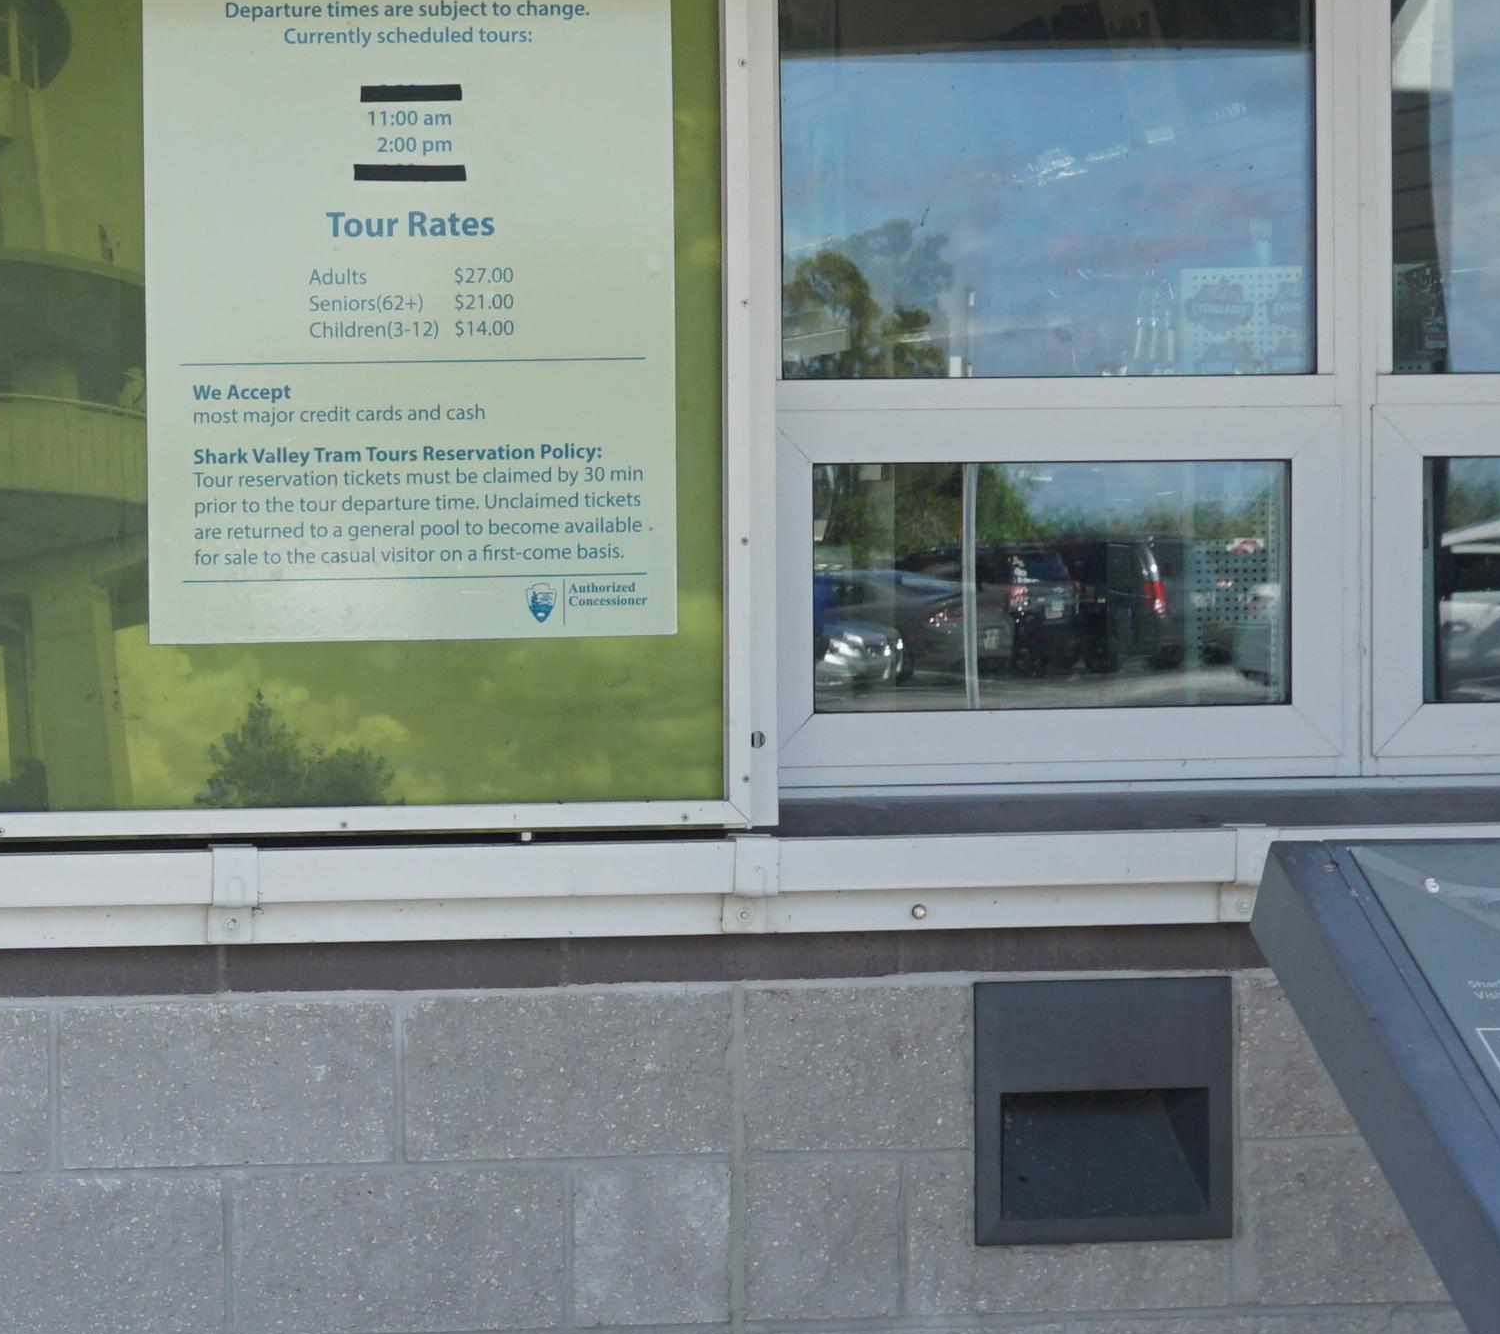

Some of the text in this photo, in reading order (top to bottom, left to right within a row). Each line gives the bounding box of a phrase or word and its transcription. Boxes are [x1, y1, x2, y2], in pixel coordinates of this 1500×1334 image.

[226, 0, 589, 22] Departure times are subject to change.
[284, 26, 532, 48] Currently scheduled tours:
[368, 110, 451, 126] 11:00 am
[377, 137, 452, 156] 2:00 pm
[326, 211, 495, 237] Tour Rates
[309, 267, 513, 285] Adults $27.00
[310, 293, 513, 313] Seniors(62+) $21.00
[310, 319, 514, 339] Children(3-12) $14.00
[193, 385, 291, 403] We Accept
[194, 404, 485, 427] most major credit cards and cash
[194, 443, 601, 467] Shark Valley Tram Tours Reservation Policy:
[568, 583, 635, 594] Authorized
[568, 595, 648, 607] Concessioner
